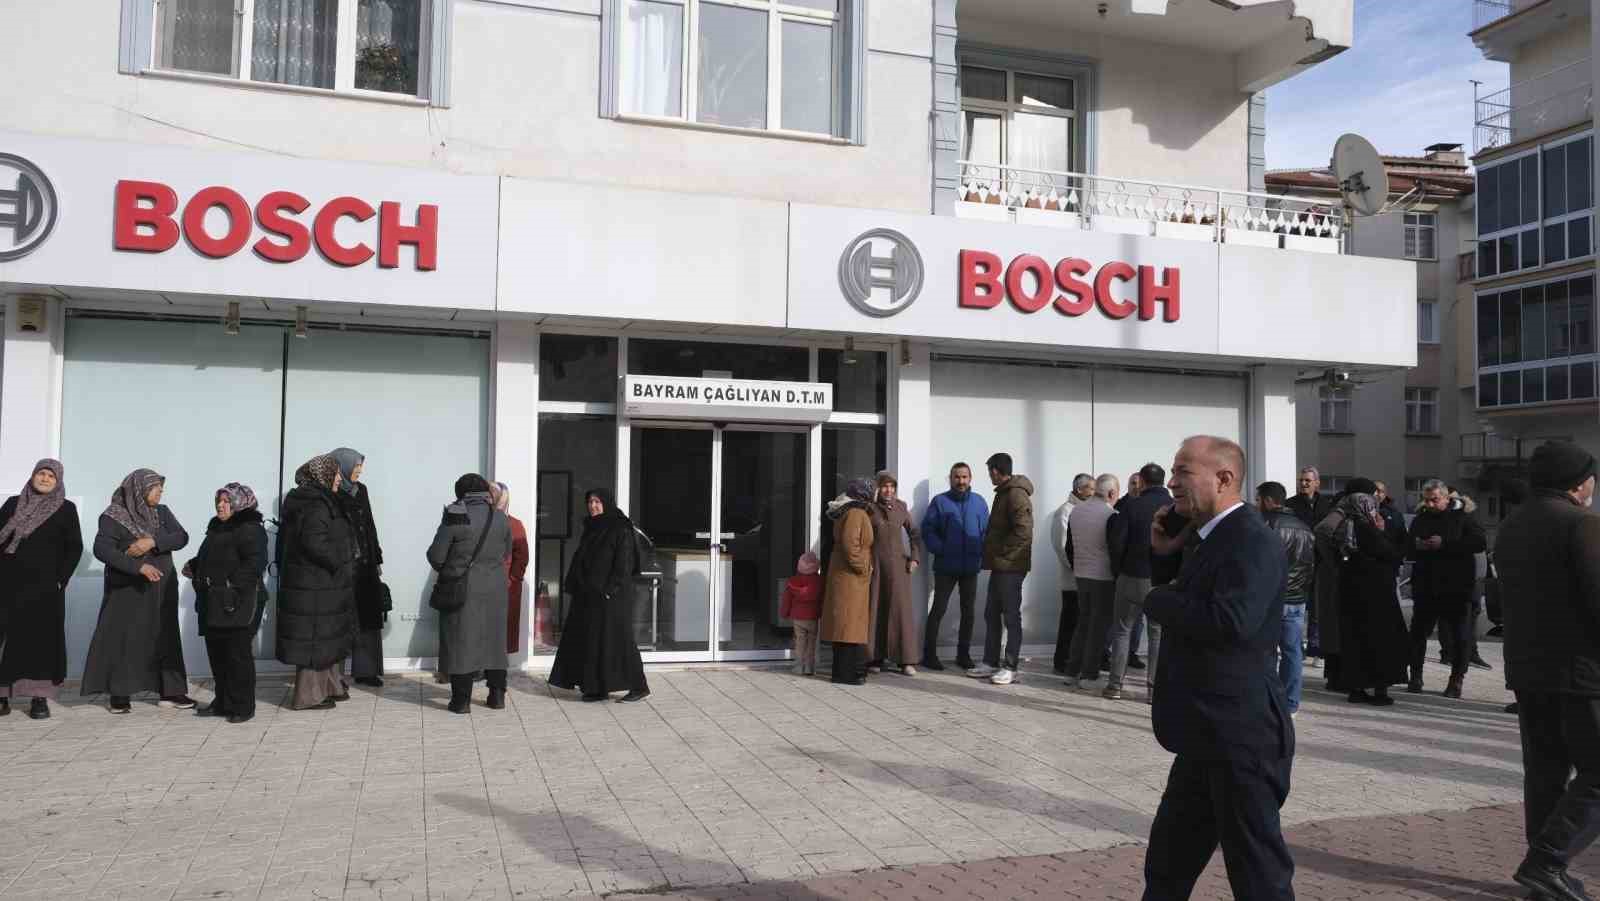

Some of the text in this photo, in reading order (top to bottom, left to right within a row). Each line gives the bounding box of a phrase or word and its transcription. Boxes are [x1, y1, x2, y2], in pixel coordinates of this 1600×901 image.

[114, 179, 438, 271] BOSCH
[959, 249, 1180, 322] BOSCH
[633, 383, 825, 404] BAYRAM ÇAĞLIYAN D.T.M
